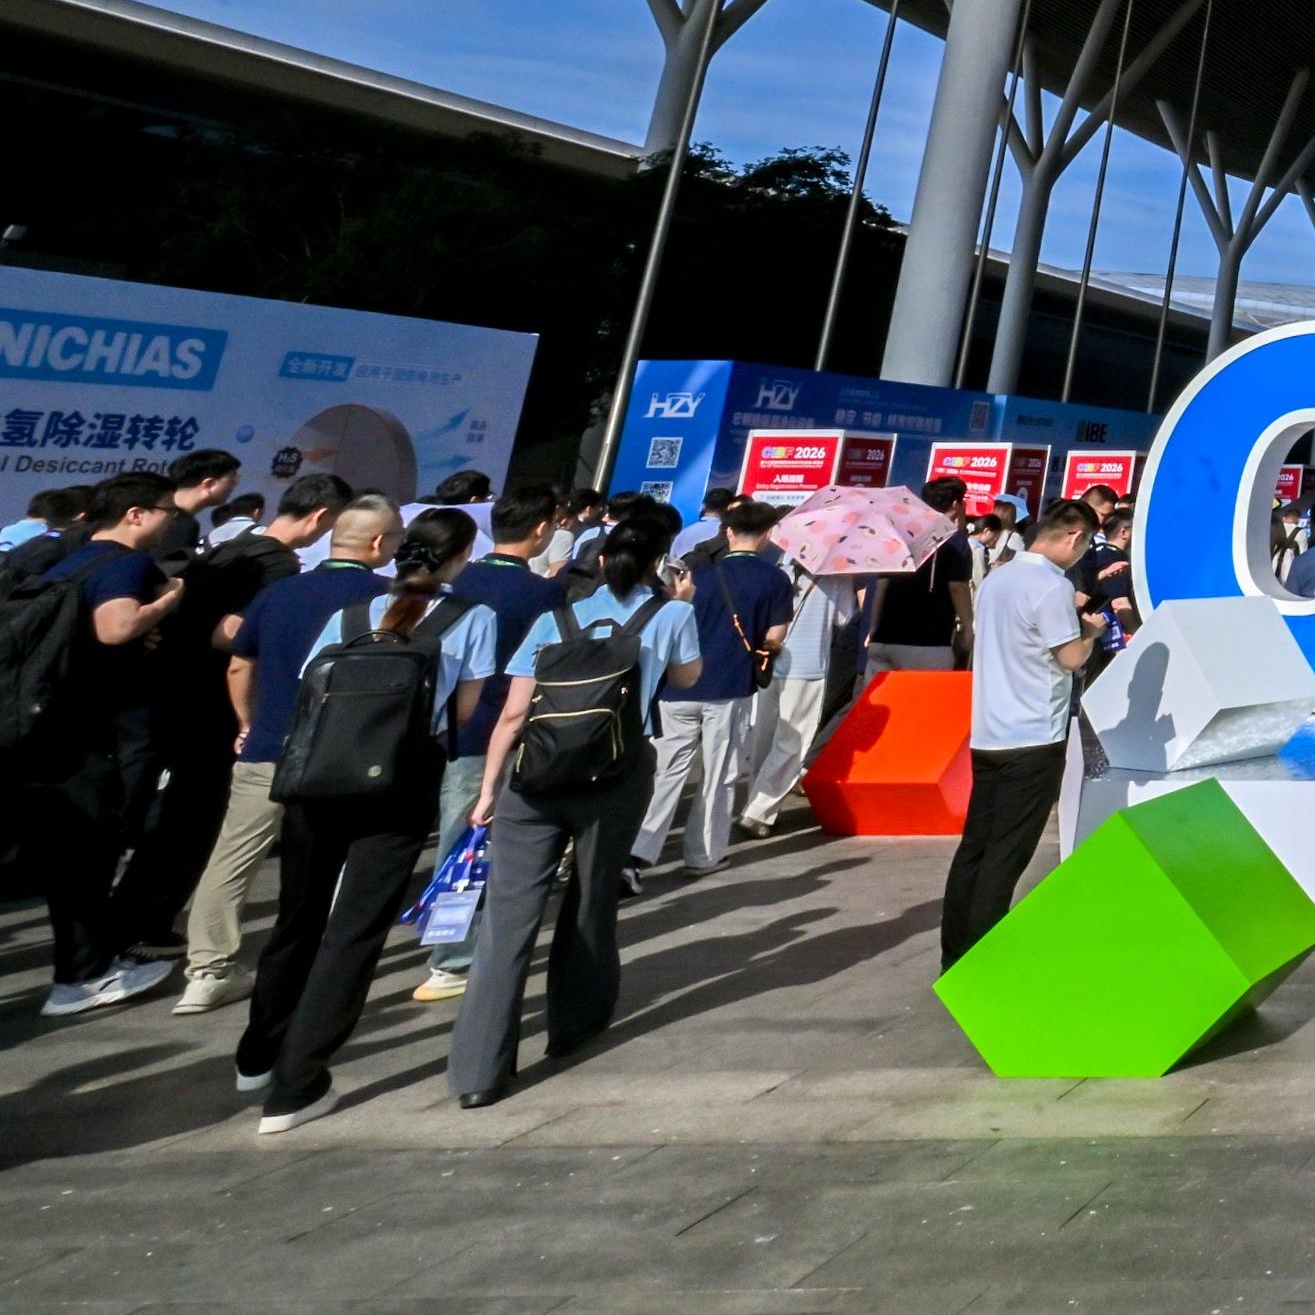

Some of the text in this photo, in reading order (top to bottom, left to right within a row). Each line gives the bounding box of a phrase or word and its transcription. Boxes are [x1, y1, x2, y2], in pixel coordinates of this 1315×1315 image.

[0, 320, 207, 380] NICHIAS
[795, 447, 827, 459] 2026
[15, 455, 128, 475] Desiccant
[132, 458, 168, 475] Rot
[970, 457, 998, 468] 2026
[1100, 463, 1124, 473] 2026
